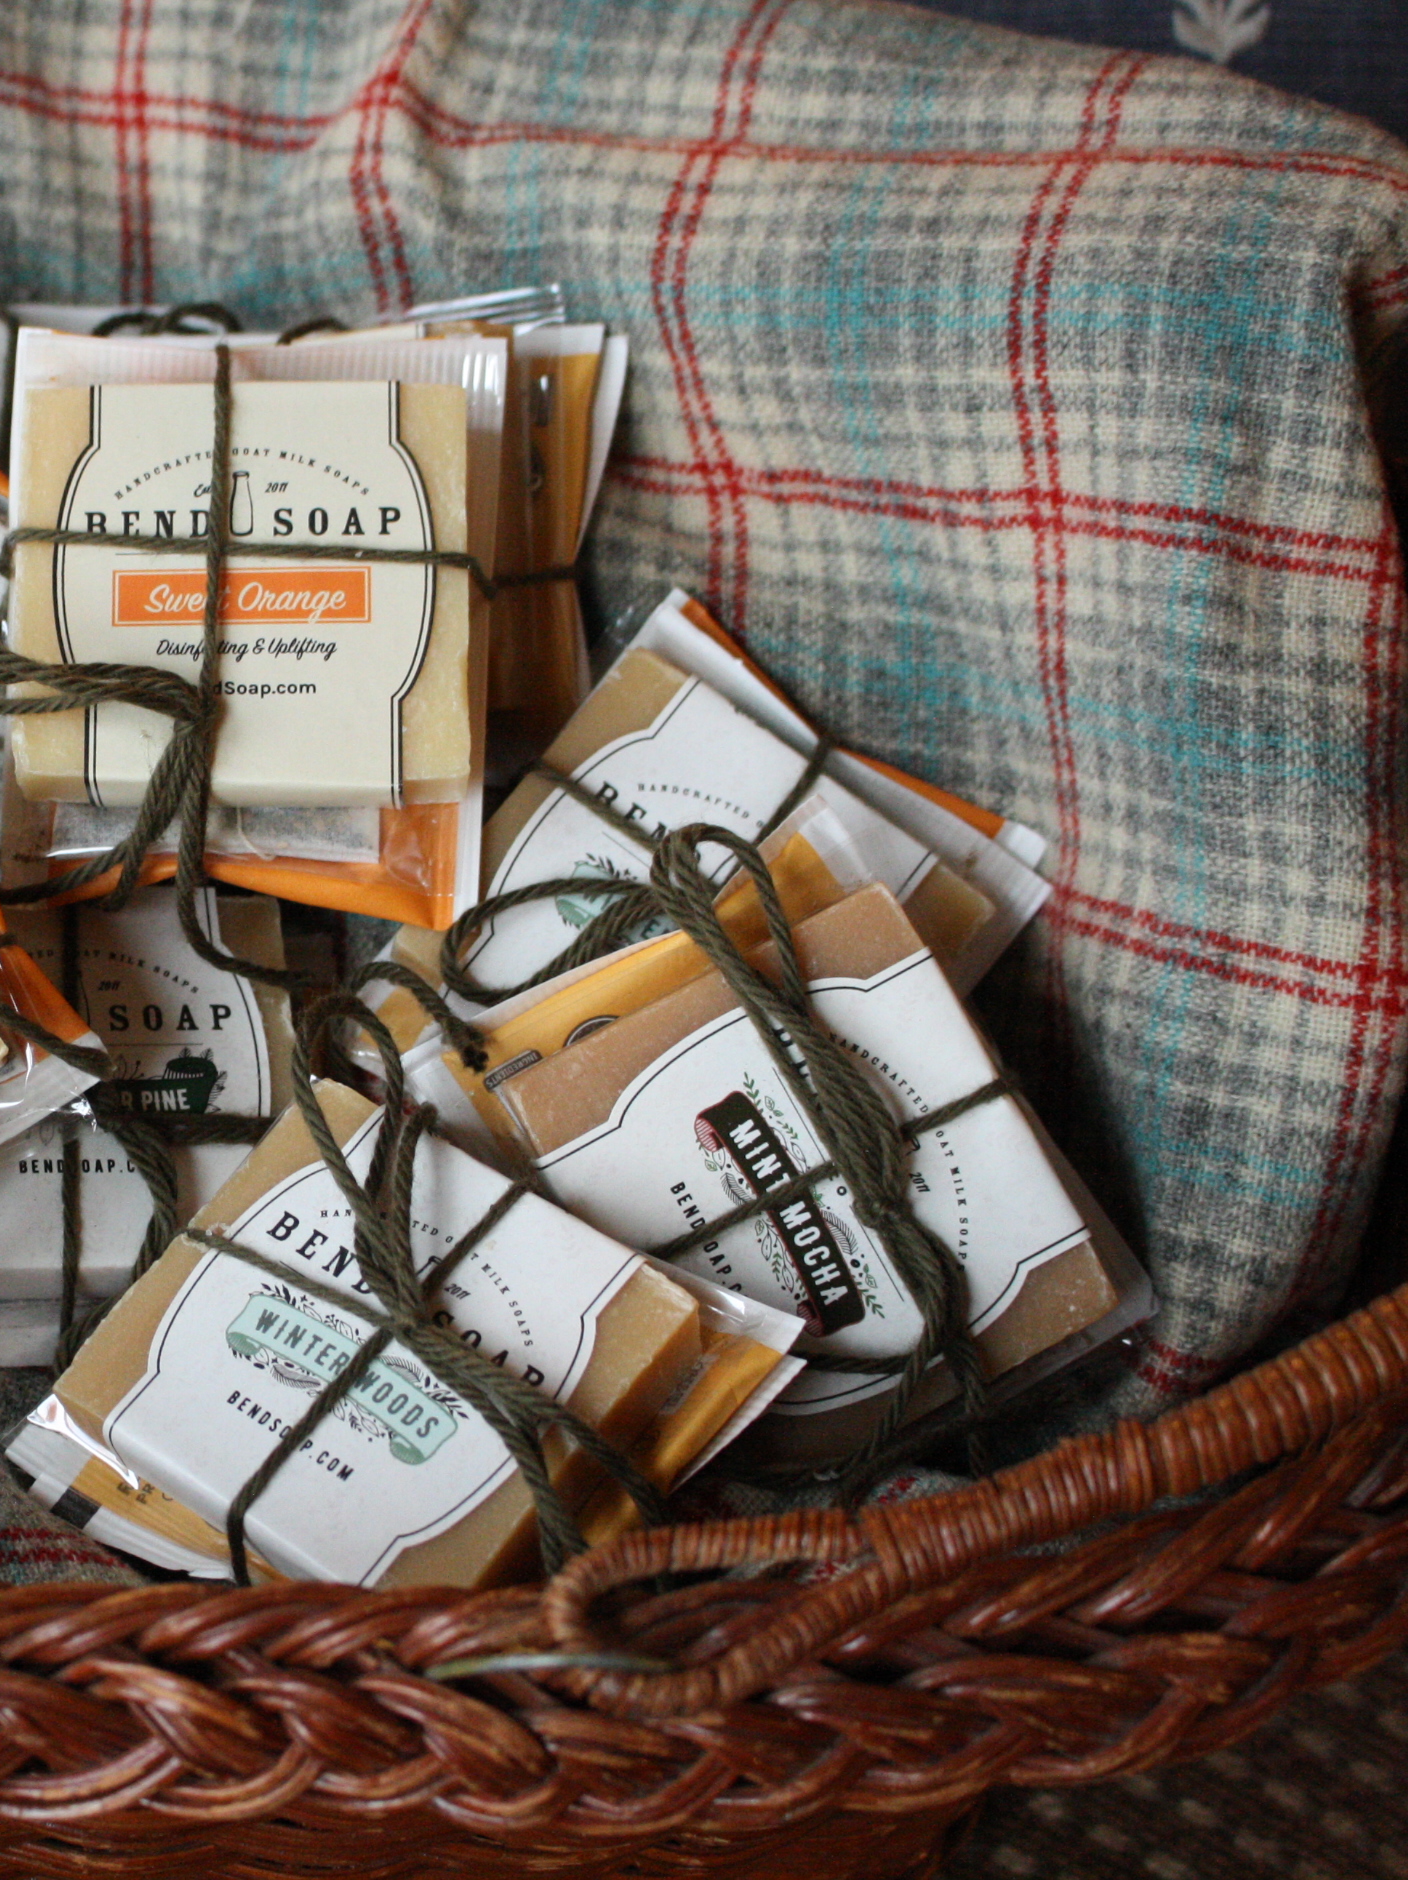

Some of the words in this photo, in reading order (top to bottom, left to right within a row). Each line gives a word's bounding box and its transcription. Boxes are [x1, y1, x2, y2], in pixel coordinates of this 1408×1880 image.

[114, 451, 212, 501] HANDCRAFTE
[279, 450, 316, 467] MILK
[323, 464, 370, 496] SOAPS
[264, 481, 289, 494] 2011
[273, 505, 402, 537] SOAP
[144, 583, 232, 614] Swet
[237, 581, 347, 624] Orange
[252, 637, 265, 654] &
[268, 637, 338, 661] Uplifting
[213, 680, 317, 699] dSoap.com
[637, 782, 750, 820] HANDCRAFTED
[153, 965, 200, 994] SOAPS
[108, 1003, 232, 1031] SOAP
[485, 1051, 540, 1089] INGREDIENTS
[141, 1088, 191, 1111] PINE
[19, 1159, 136, 1174] BENDOAP.C
[935, 1130, 954, 1158] OAT
[950, 1166, 967, 1206] MILK
[729, 1118, 791, 1194] MINT
[779, 1200, 849, 1306] MOCHA
[670, 1181, 743, 1292] BENDOAP.C
[443, 1283, 471, 1300] 2011
[480, 1263, 510, 1295] MILK
[509, 1300, 534, 1348] SOAPS
[254, 1308, 352, 1376] WINTER
[353, 1366, 440, 1439] WOODS
[226, 1390, 355, 1482] BENDSOP.COM
